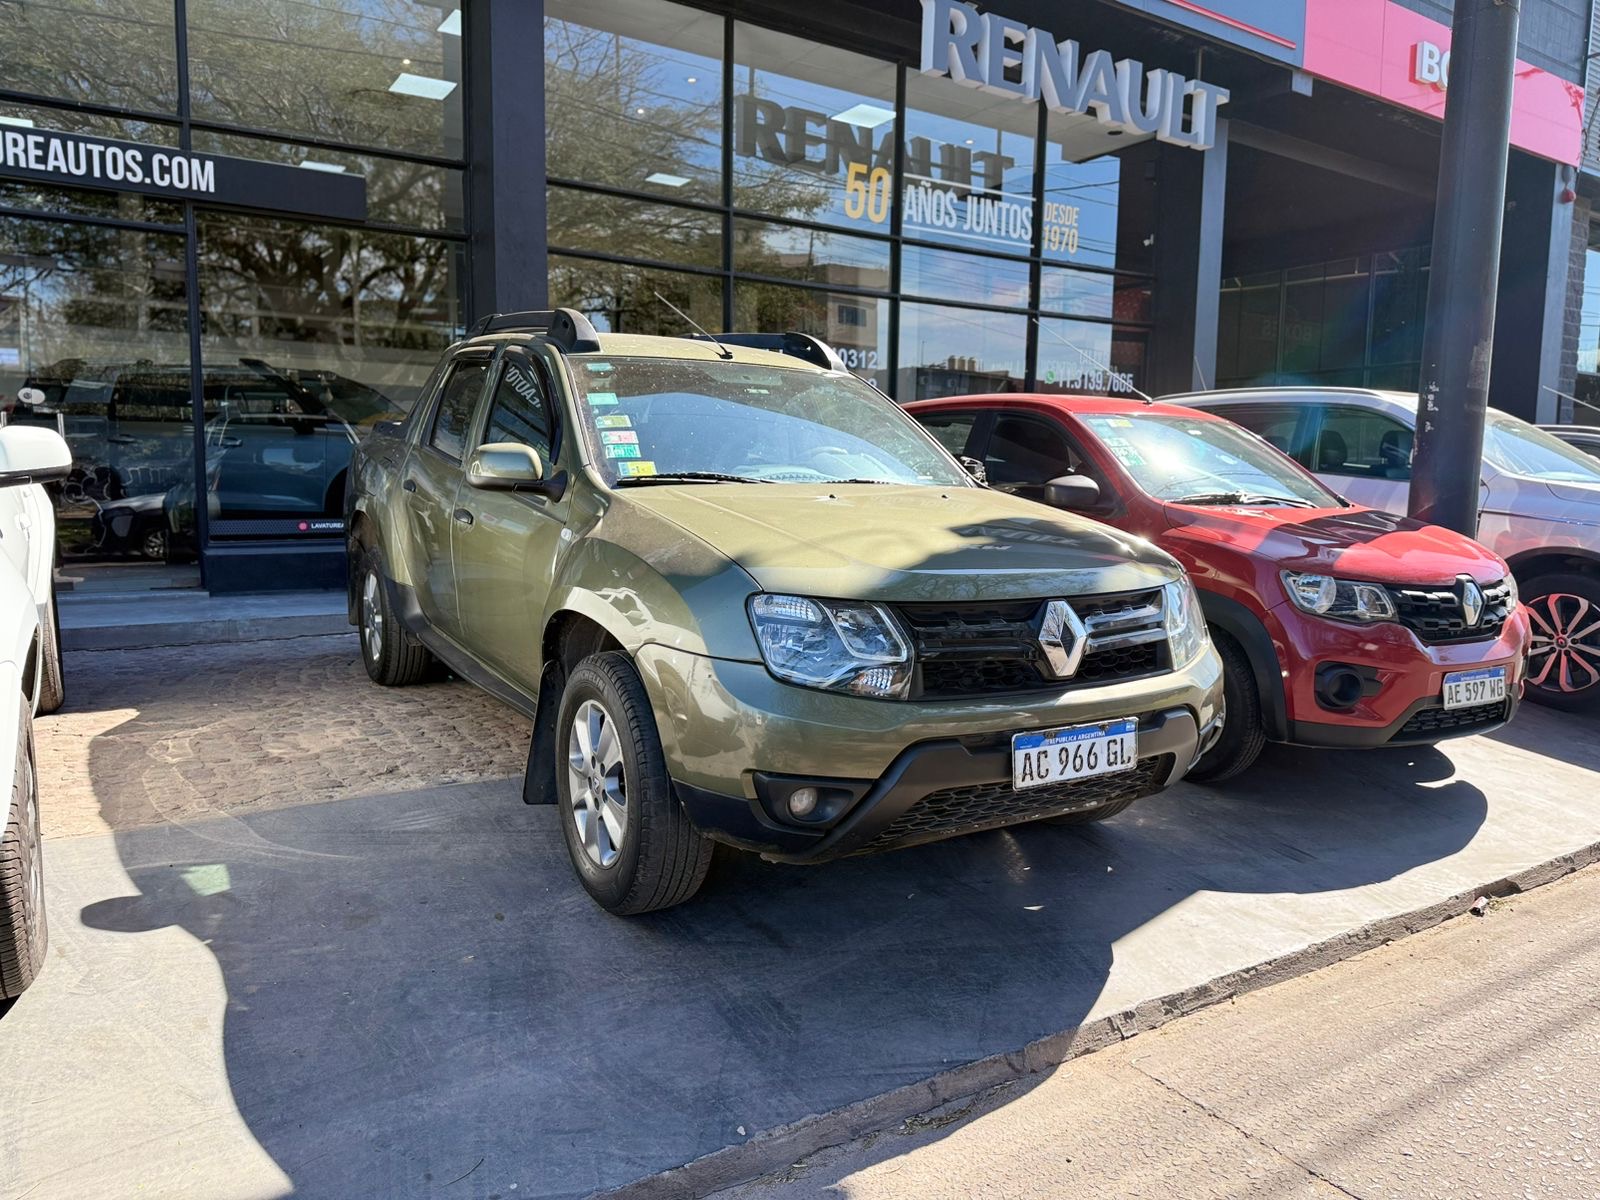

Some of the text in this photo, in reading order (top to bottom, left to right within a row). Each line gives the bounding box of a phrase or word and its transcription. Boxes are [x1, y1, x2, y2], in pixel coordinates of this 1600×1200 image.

[921, 0, 1230, 150] RENAULT
[0, 131, 215, 193] REAUTOS.COM
[845, 162, 1033, 241] 50 AÑOS JUNTOS
[1044, 202, 1080, 227] DESDE
[1043, 226, 1079, 254] 1970
[1447, 684, 1461, 704] AE
[1465, 680, 1485, 701] 597
[1077, 730, 1106, 741] ARGENTINA
[1021, 737, 1131, 782] AC 966 GL
